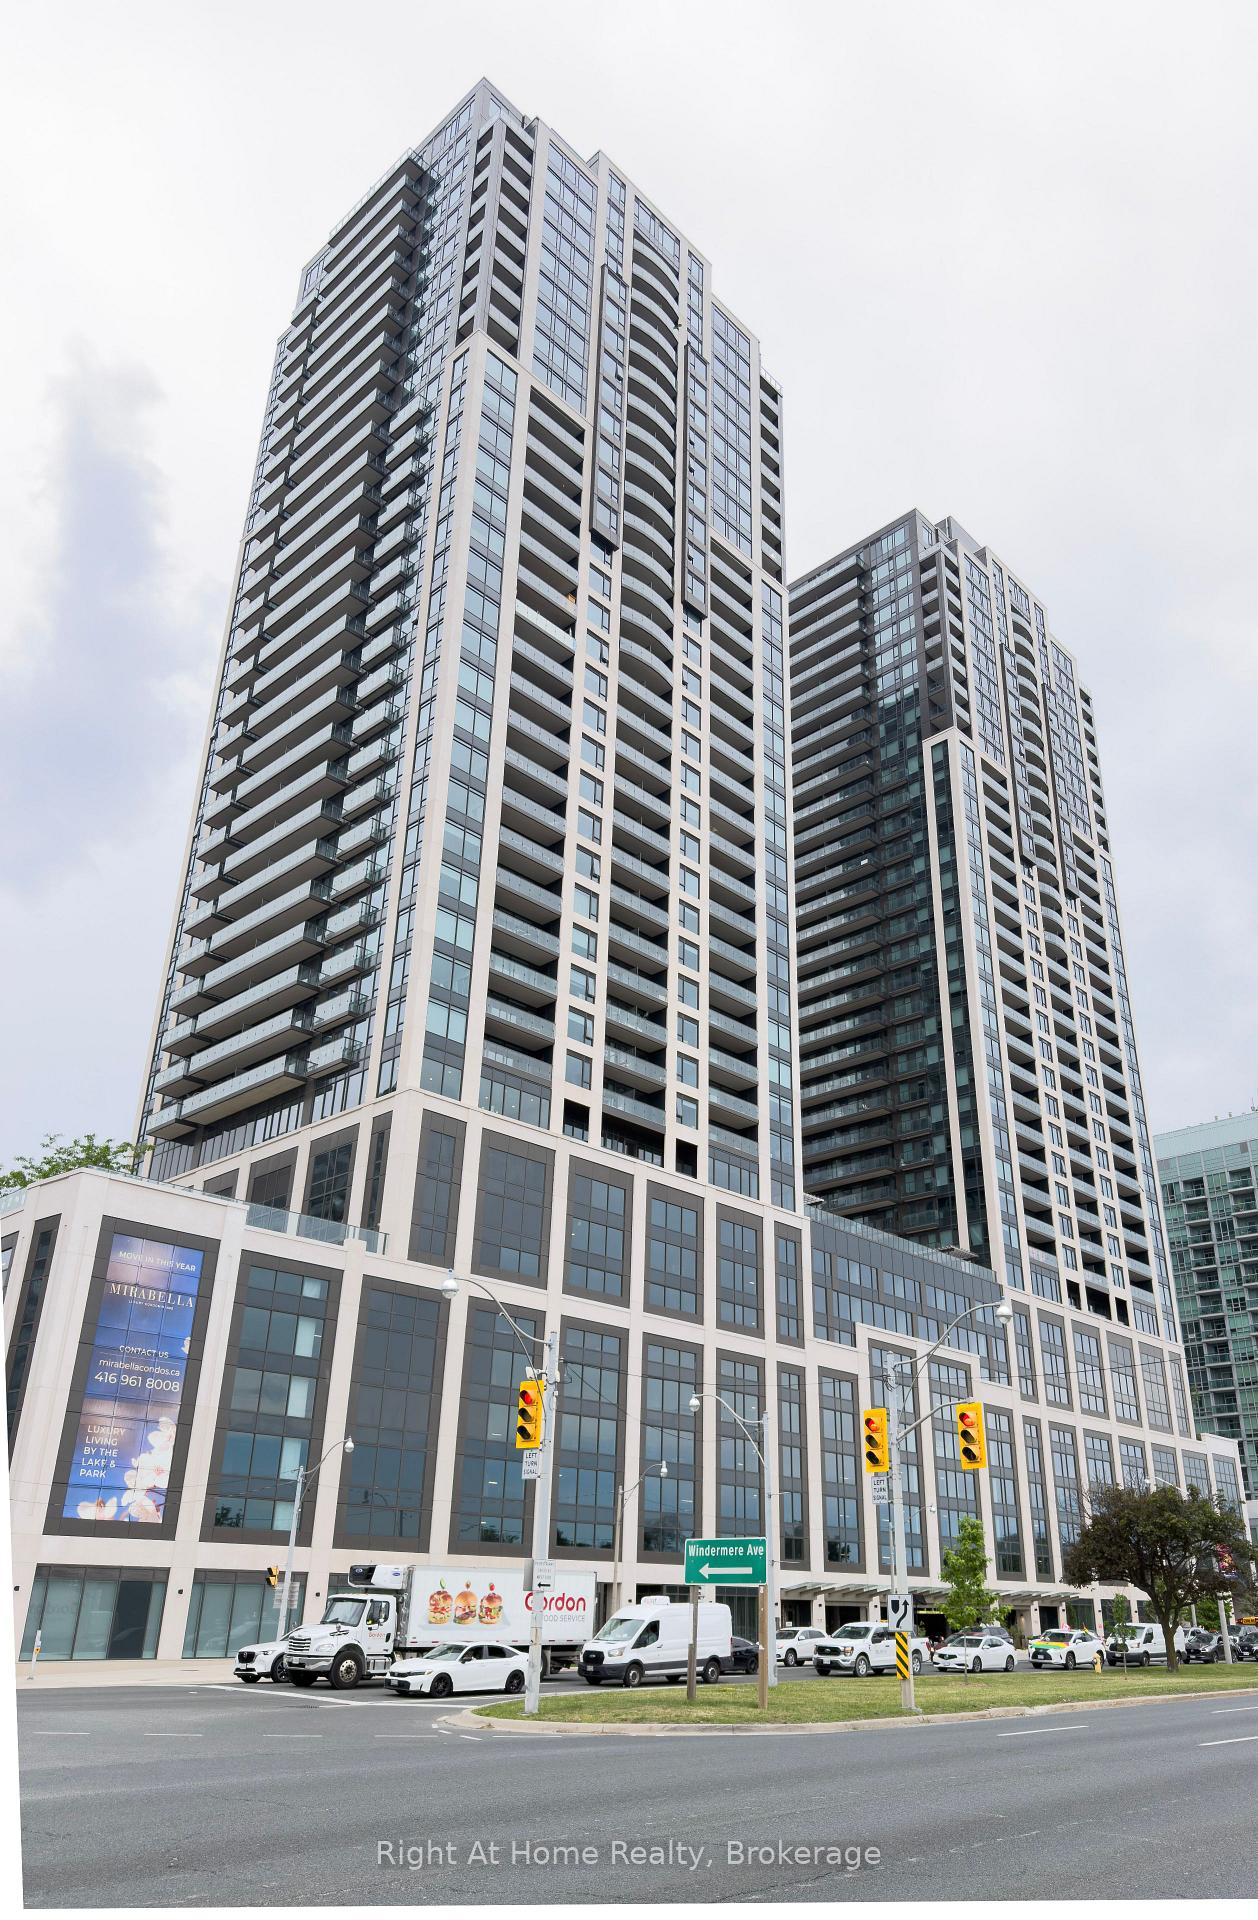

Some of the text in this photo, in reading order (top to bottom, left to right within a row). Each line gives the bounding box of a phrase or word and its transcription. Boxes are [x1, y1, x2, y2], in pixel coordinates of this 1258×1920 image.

[145, 1256, 154, 1264] IN
[156, 1258, 174, 1268] THIS
[175, 1261, 196, 1272] YEAR
[109, 1283, 194, 1308] MIRABELLA
[119, 1345, 169, 1359] CONTACT US
[98, 1359, 180, 1377] mirabellacondos.ca
[94, 1371, 180, 1393] 416 961 8008
[87, 1425, 125, 1436] LUXURY
[85, 1435, 118, 1446] LIVING
[84, 1447, 118, 1457] BY THE
[81, 1458, 107, 1467] LAKE
[79, 1468, 107, 1478] PARK
[688, 1544, 764, 1556] Windermere Ave
[559, 1614, 585, 1622] SERVICE
